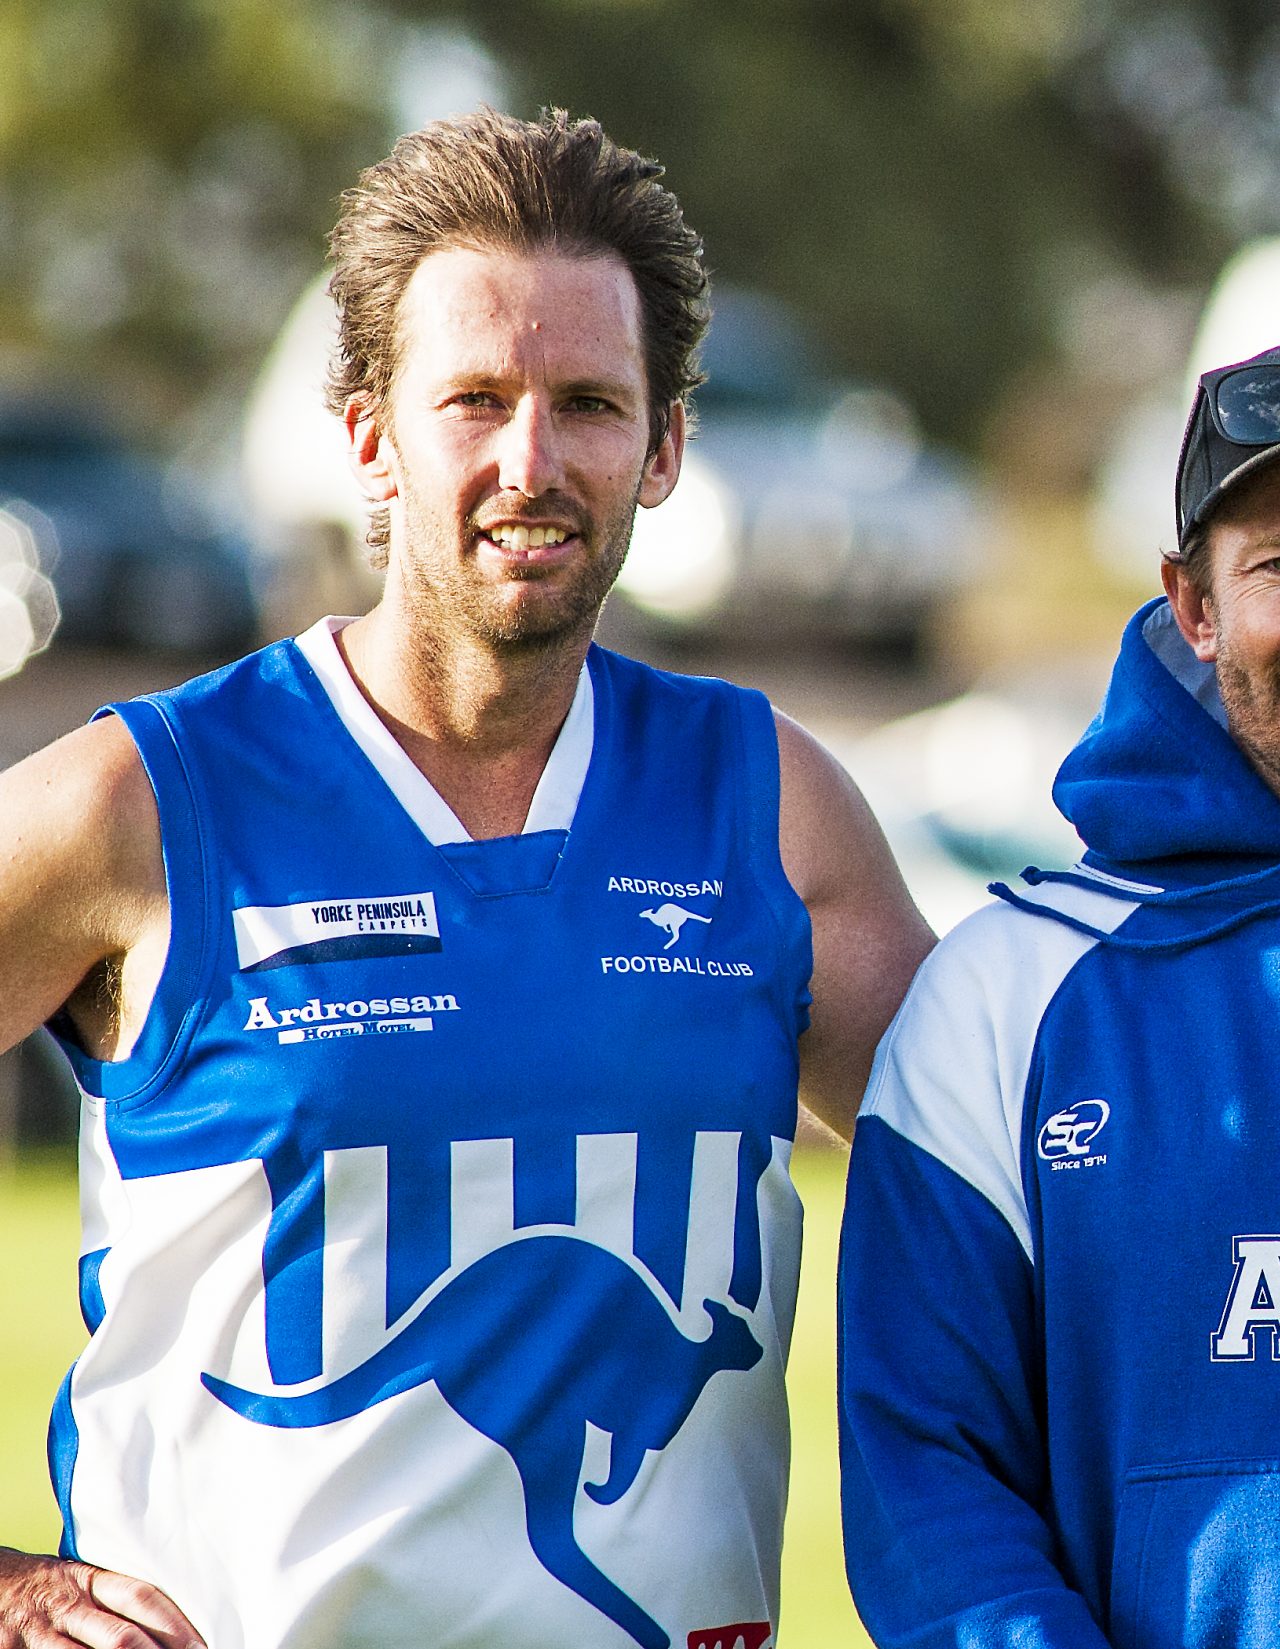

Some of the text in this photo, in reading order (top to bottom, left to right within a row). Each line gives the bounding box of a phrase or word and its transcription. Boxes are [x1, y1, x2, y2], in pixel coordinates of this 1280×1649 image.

[607, 876, 723, 898] ARDROSSAN
[311, 900, 426, 924] YORKE PENINSULA
[358, 918, 427, 931] CARPETS
[600, 956, 754, 976] FOOTBALL CLUB
[243, 994, 461, 1031] Ardrossan
[1083, 1154, 1107, 1167] 1974
